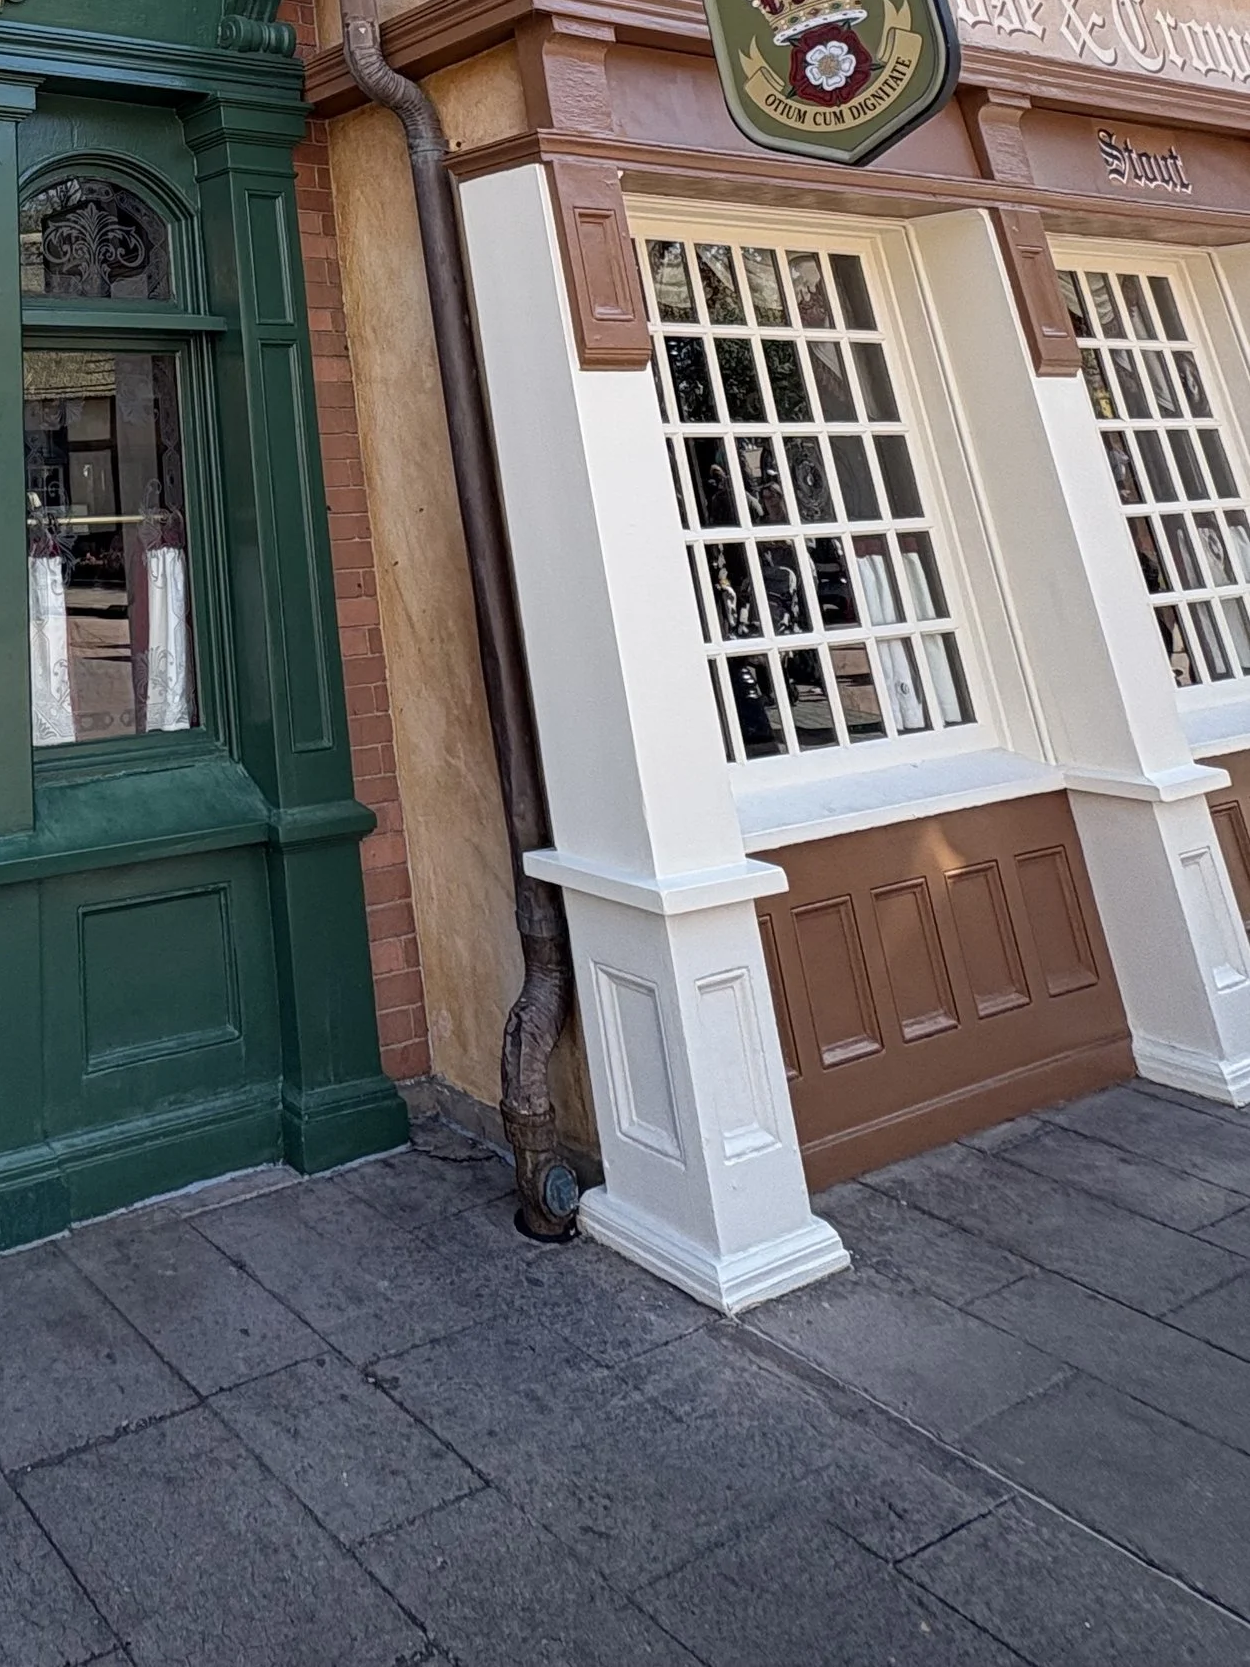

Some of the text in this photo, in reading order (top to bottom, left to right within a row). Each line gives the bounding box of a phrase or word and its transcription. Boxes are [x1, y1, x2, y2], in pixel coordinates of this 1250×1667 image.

[764, 56, 913, 126] OTIUM CUM DIGNITATE
[1097, 128, 1192, 194] Stout
